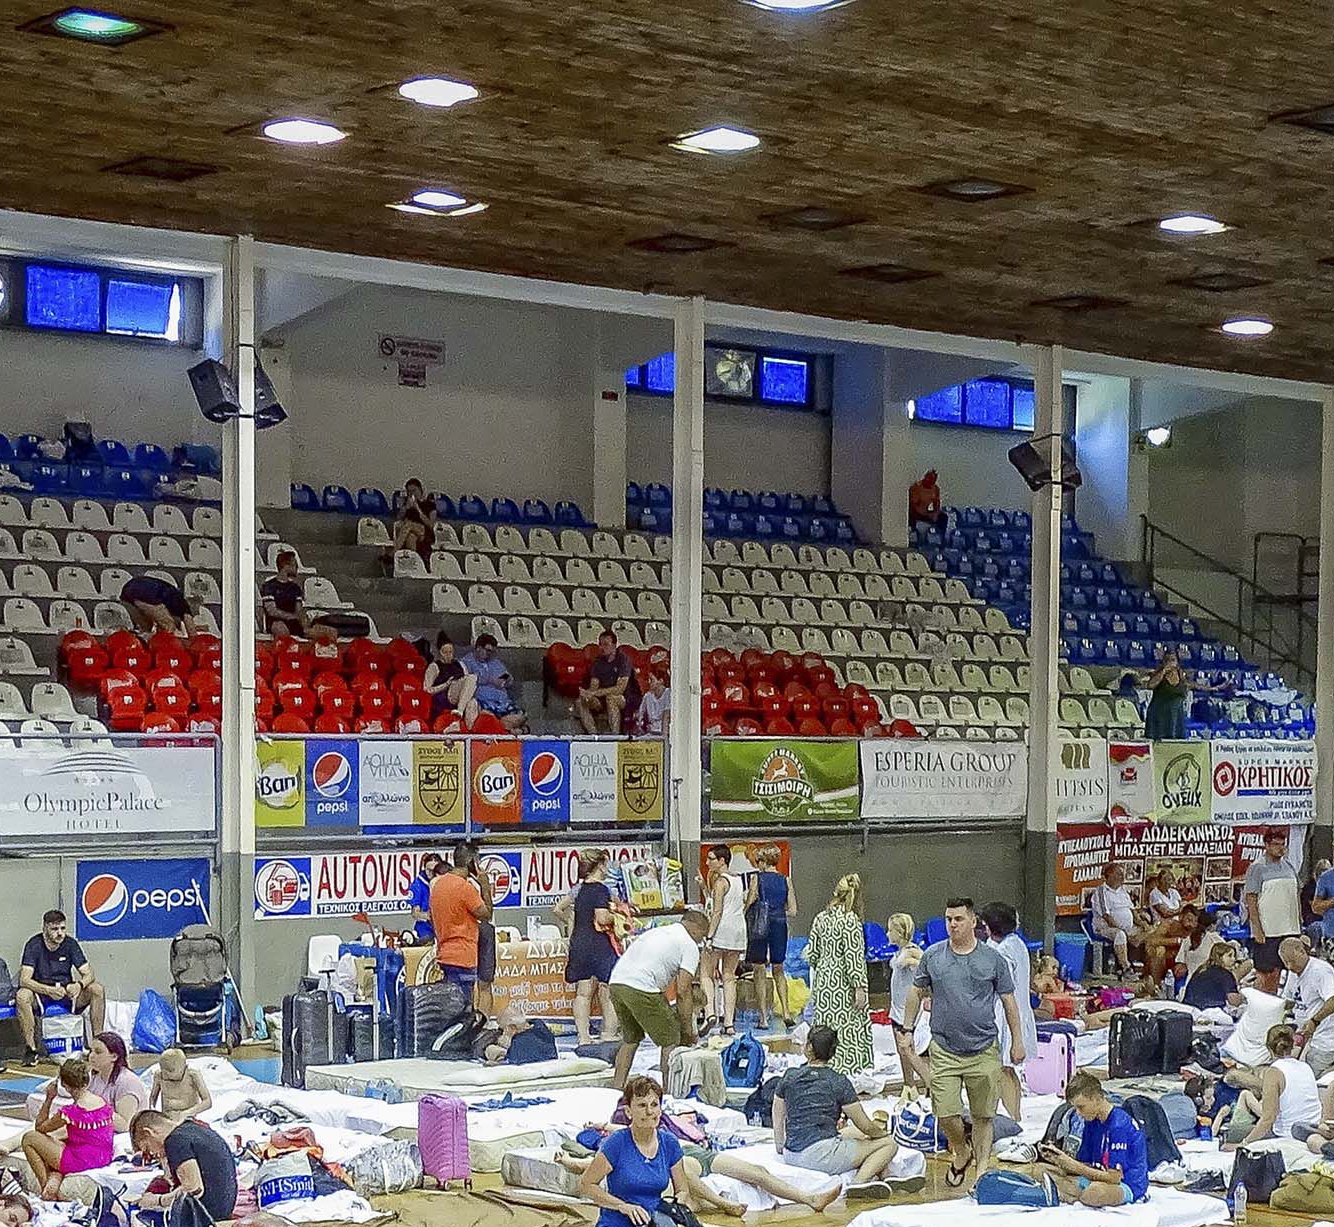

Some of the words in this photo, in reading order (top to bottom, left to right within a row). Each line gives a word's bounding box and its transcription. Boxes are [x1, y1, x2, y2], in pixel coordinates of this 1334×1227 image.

[875, 751, 945, 773] ESPERIA
[950, 751, 1017, 773] GROUP
[1237, 765, 1314, 788] ΚΡΗΤΙΚΟΣ
[753, 779, 812, 799] ΤΣΙΣΙΜΟΙΡΗ
[316, 801, 349, 815] pepsi
[531, 798, 562, 813] pepsi
[66, 818, 125, 832] HOTEL
[1141, 825, 1236, 843] ΔΩΔΕΚΑΝΗΣΟΣ
[1114, 842, 1167, 857] ΜΠΑΣΚΕΤ
[1168, 842, 1185, 856] ΜΕ
[1186, 840, 1235, 856] ΑΜΑΞΙΔΙΟ
[132, 884, 201, 912] pepsi
[319, 901, 361, 915] ΤΕΧΝΙΚΟΣ
[362, 900, 399, 913] ΕΛΕΓΧΟΣ
[529, 962, 566, 977] ΜΠΑΣ
